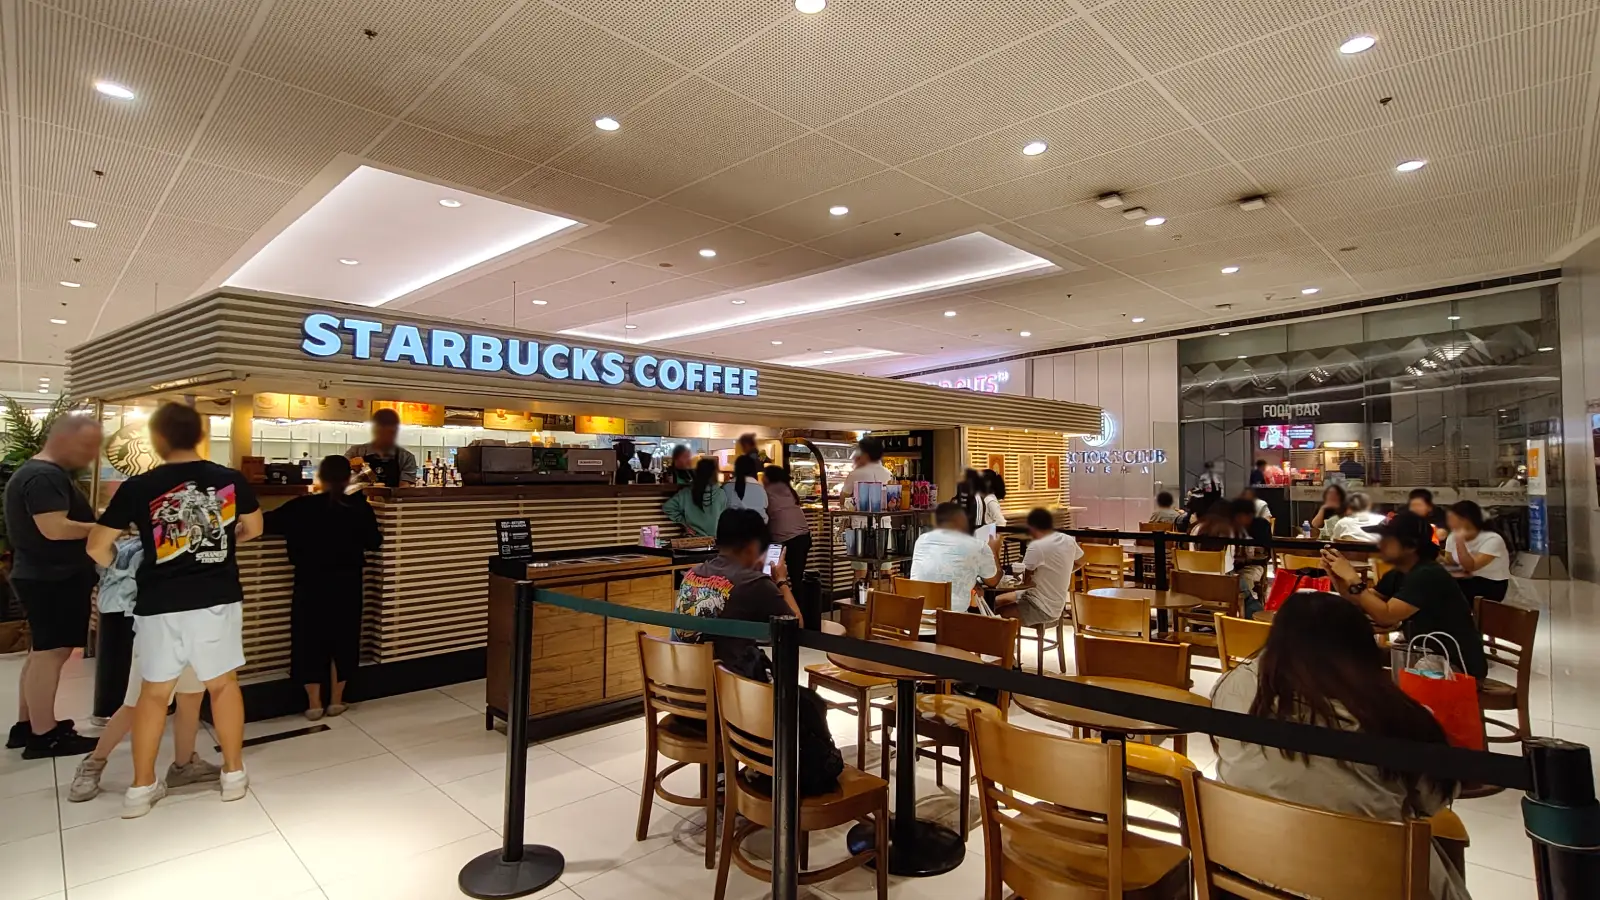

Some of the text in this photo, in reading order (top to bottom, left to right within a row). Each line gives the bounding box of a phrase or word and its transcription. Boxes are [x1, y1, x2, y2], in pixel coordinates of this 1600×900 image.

[302, 313, 760, 396] STARBUCKS COFFEE
[1263, 403, 1321, 418] FOOD BAR
[1070, 465, 1149, 474] INEMA
